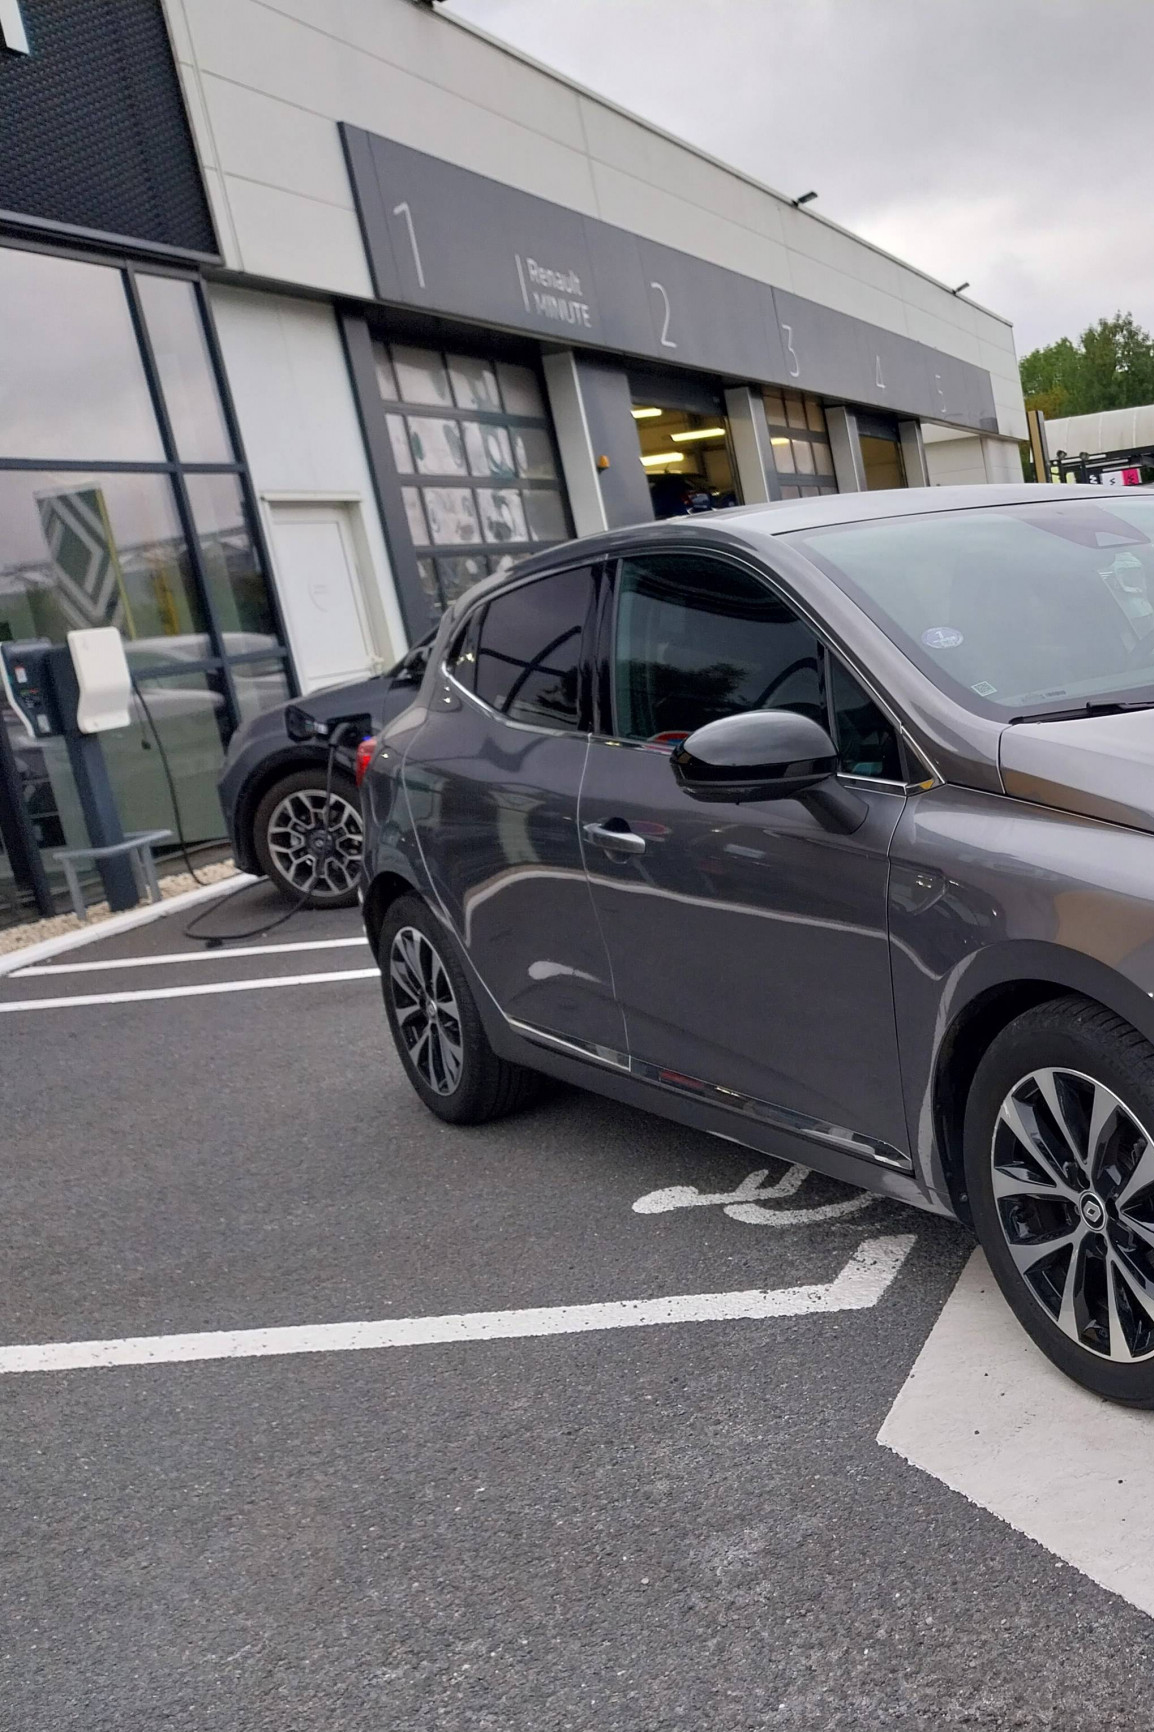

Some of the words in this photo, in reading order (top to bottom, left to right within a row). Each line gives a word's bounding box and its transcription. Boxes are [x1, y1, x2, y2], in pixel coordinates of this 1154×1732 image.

[393, 202, 426, 288] 1
[526, 257, 583, 296] Renault
[533, 292, 592, 328] MINUTE
[651, 282, 677, 348] 2
[781, 323, 800, 377] 3
[875, 355, 886, 389] 4
[935, 374, 947, 413] 5
